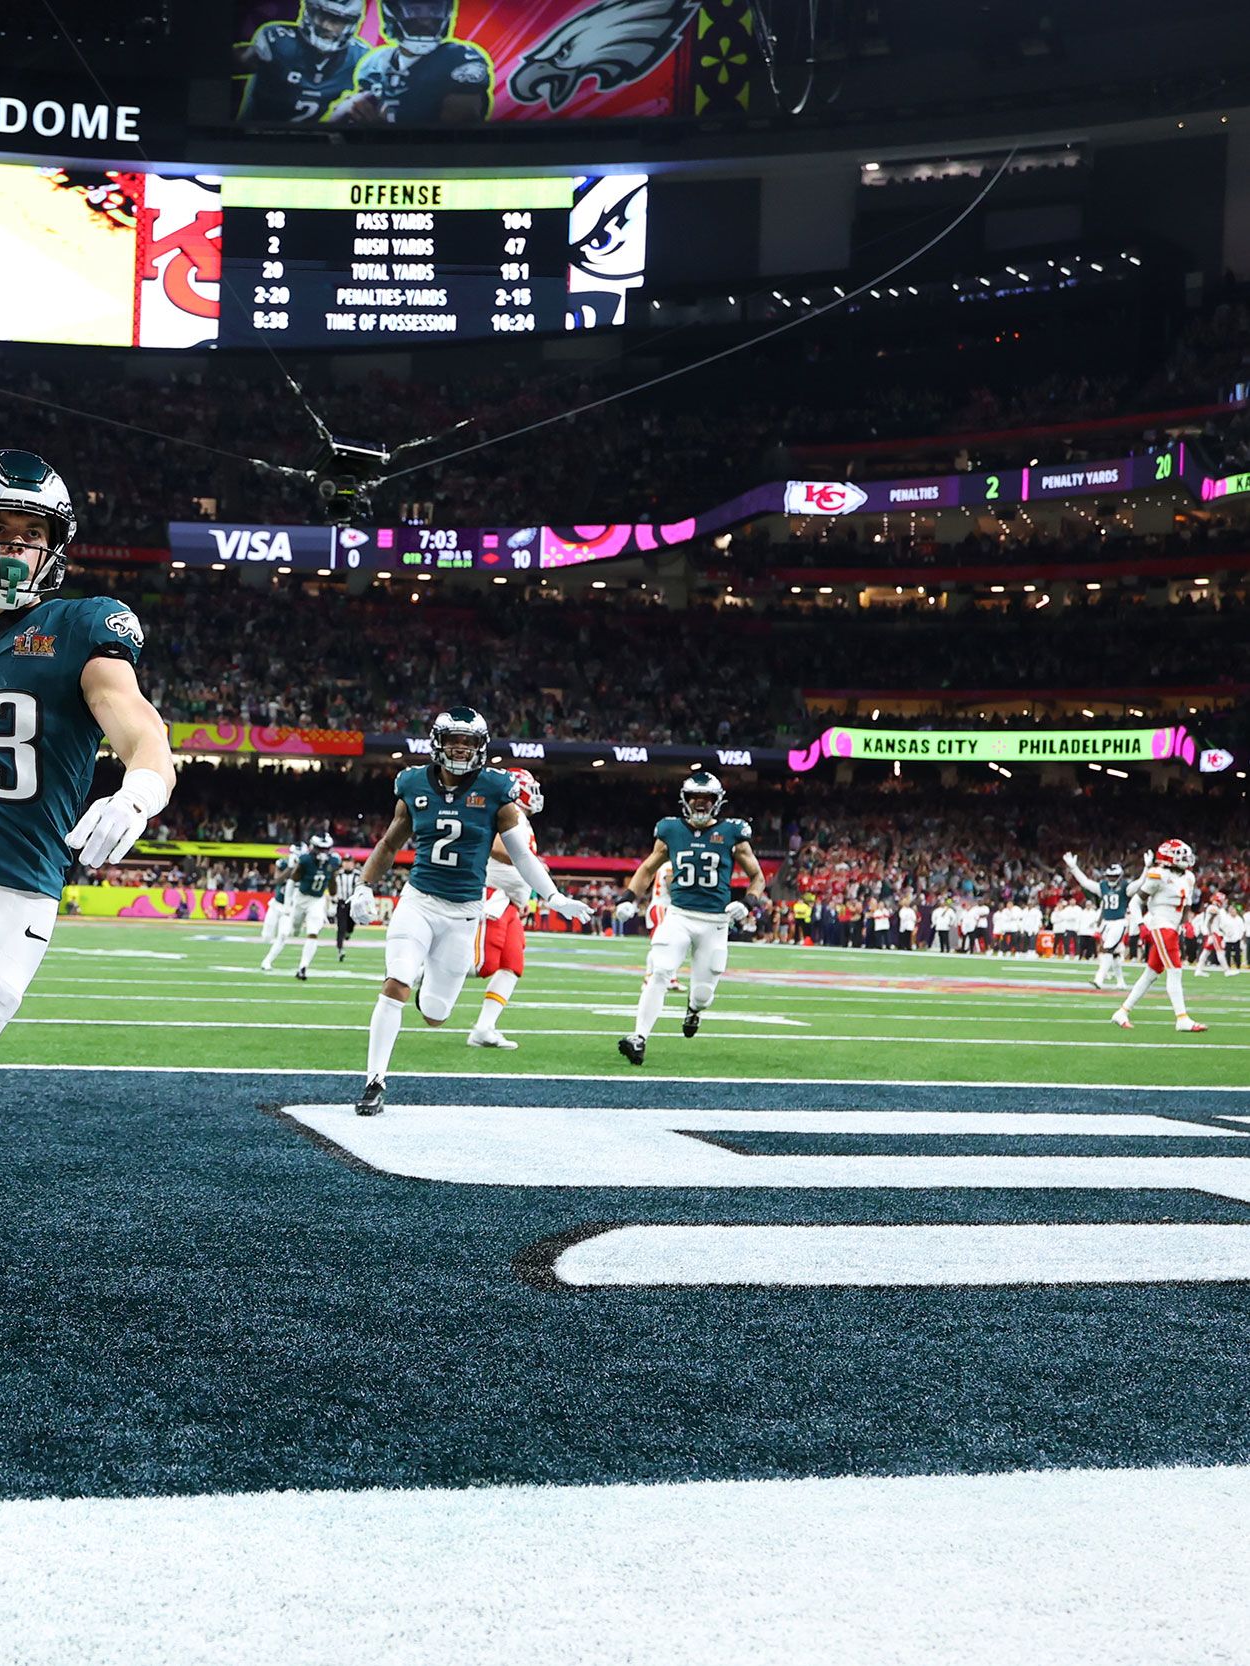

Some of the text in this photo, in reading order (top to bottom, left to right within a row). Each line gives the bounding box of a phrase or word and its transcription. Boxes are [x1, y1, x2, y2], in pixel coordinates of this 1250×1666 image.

[351, 185, 441, 204] OFFENSE
[356, 213, 389, 230] PASS
[391, 212, 434, 230] YARDS
[268, 236, 526, 255] 2 RUSH YARDS 47
[351, 263, 390, 281] TOTAL
[392, 263, 434, 281] YARDS
[500, 263, 529, 280] 151
[336, 289, 448, 306] PENALTIES-YARDS
[495, 288, 531, 306] 2-15
[325, 313, 356, 331] TIME
[359, 313, 377, 331] OF
[379, 314, 456, 331] POSSESSION
[1155, 453, 1171, 480] 20
[985, 475, 999, 499] 2
[1041, 468, 1118, 489] PENALTY YARDS
[889, 486, 939, 502] PENALTIES
[208, 529, 293, 562] VISA
[418, 530, 458, 549] 7:03
[347, 548, 360, 568] 0
[511, 549, 531, 569] 10
[405, 738, 433, 753] VIS
[510, 742, 545, 758] VISA
[613, 746, 648, 762] VISA
[863, 737, 1142, 755] KANSAS CITY PHILADELPHIA
[717, 750, 751, 766] VISA
[430, 818, 463, 867] 2
[676, 850, 721, 888] 53
